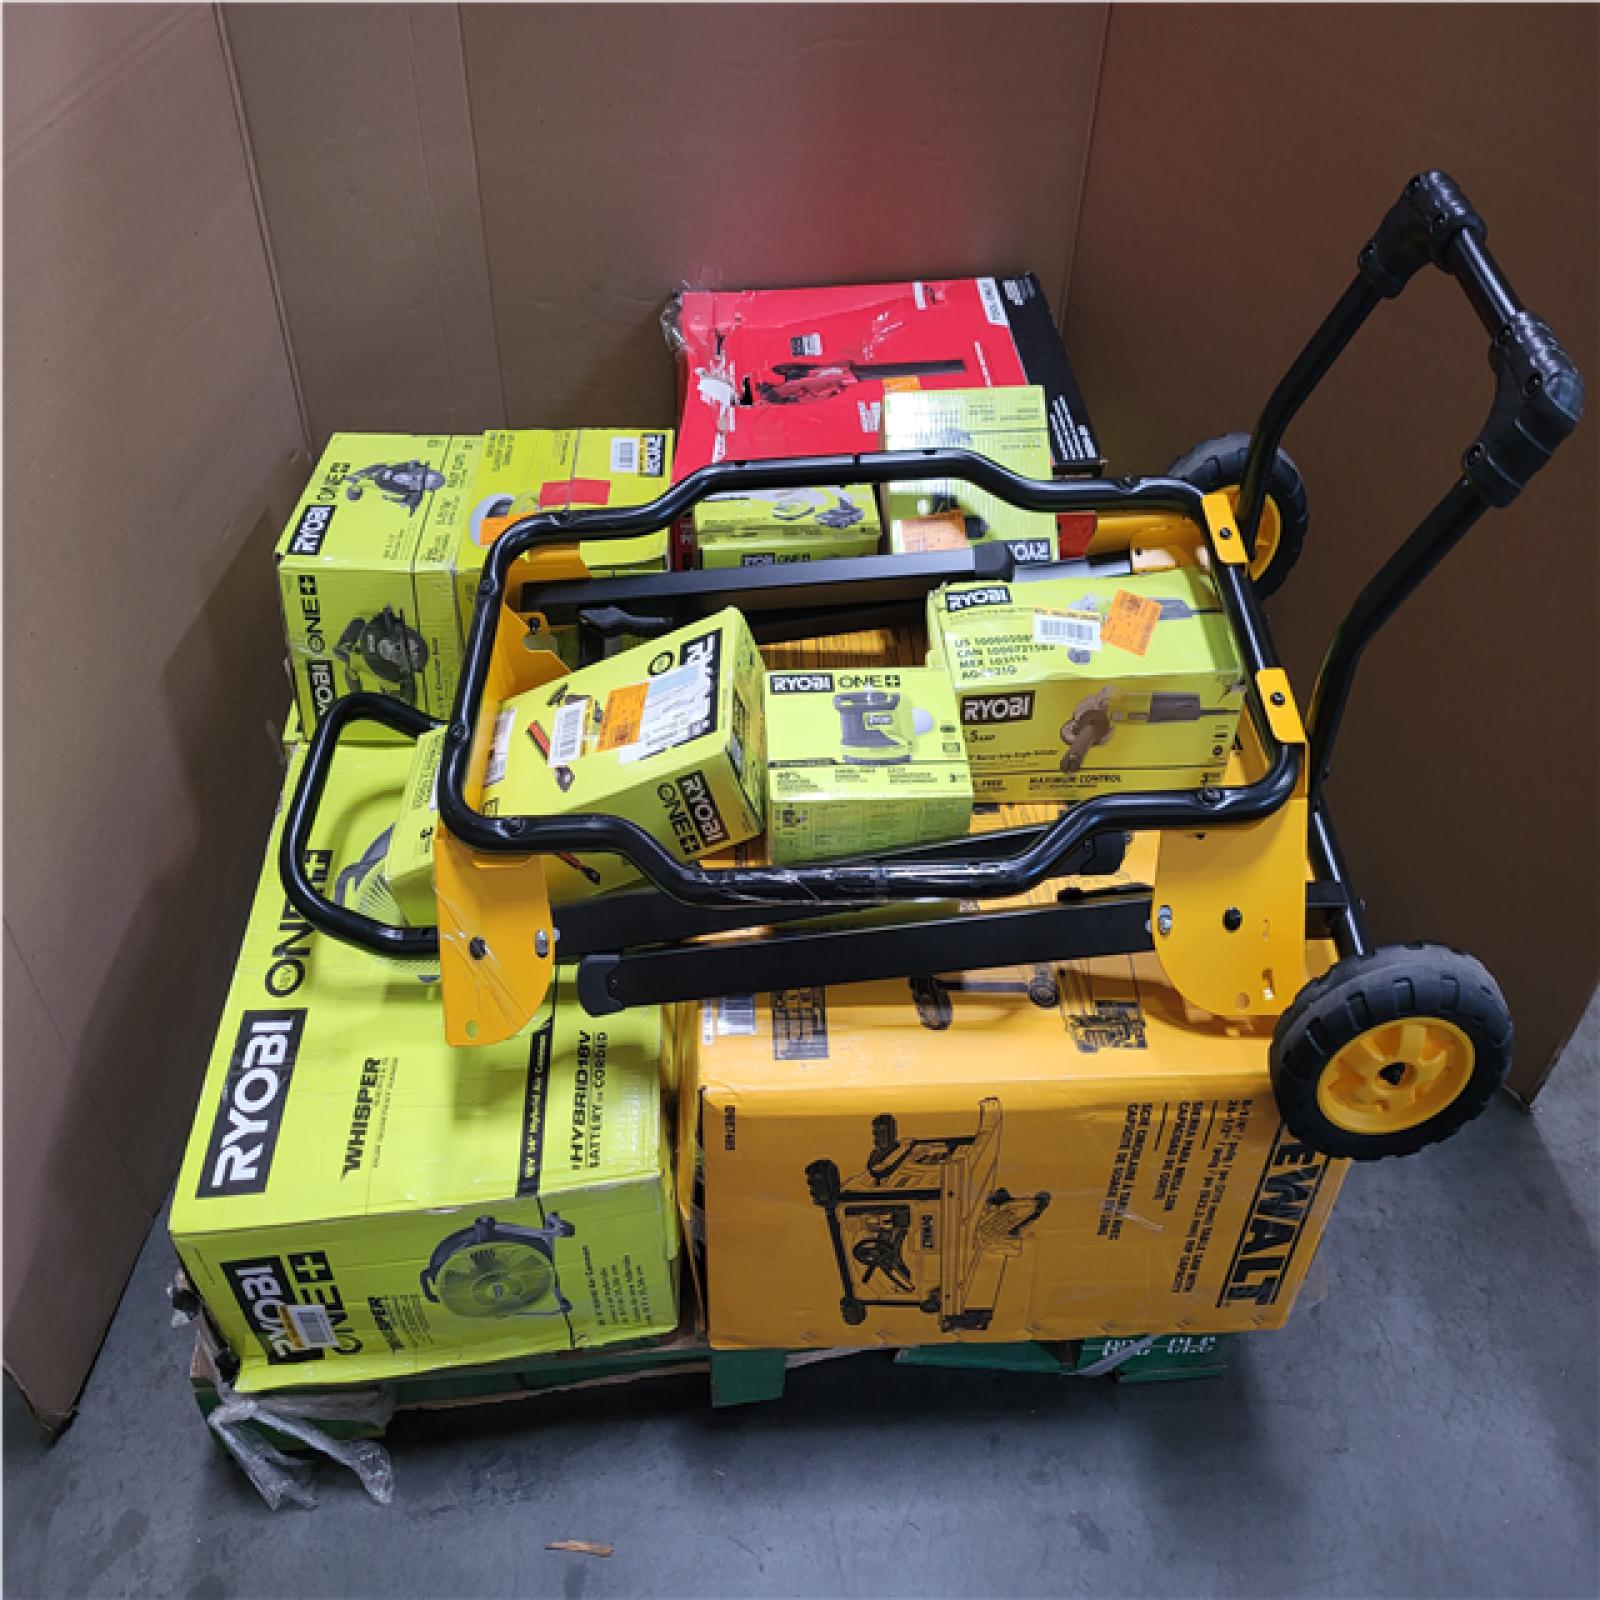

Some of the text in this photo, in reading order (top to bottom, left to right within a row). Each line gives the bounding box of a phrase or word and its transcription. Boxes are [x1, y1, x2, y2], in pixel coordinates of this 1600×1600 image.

[947, 587, 1007, 612] RYOBI
[311, 664, 333, 716] YOBI
[773, 674, 901, 693] RYOBI ONE+
[963, 694, 1031, 722] RYOBI
[657, 783, 700, 856] ONE+
[681, 773, 724, 846] RYOBI
[210, 1018, 295, 1189] RYOBI
[342, 1056, 382, 1181] WHISPER
[1226, 1144, 1321, 1305] EWALT
